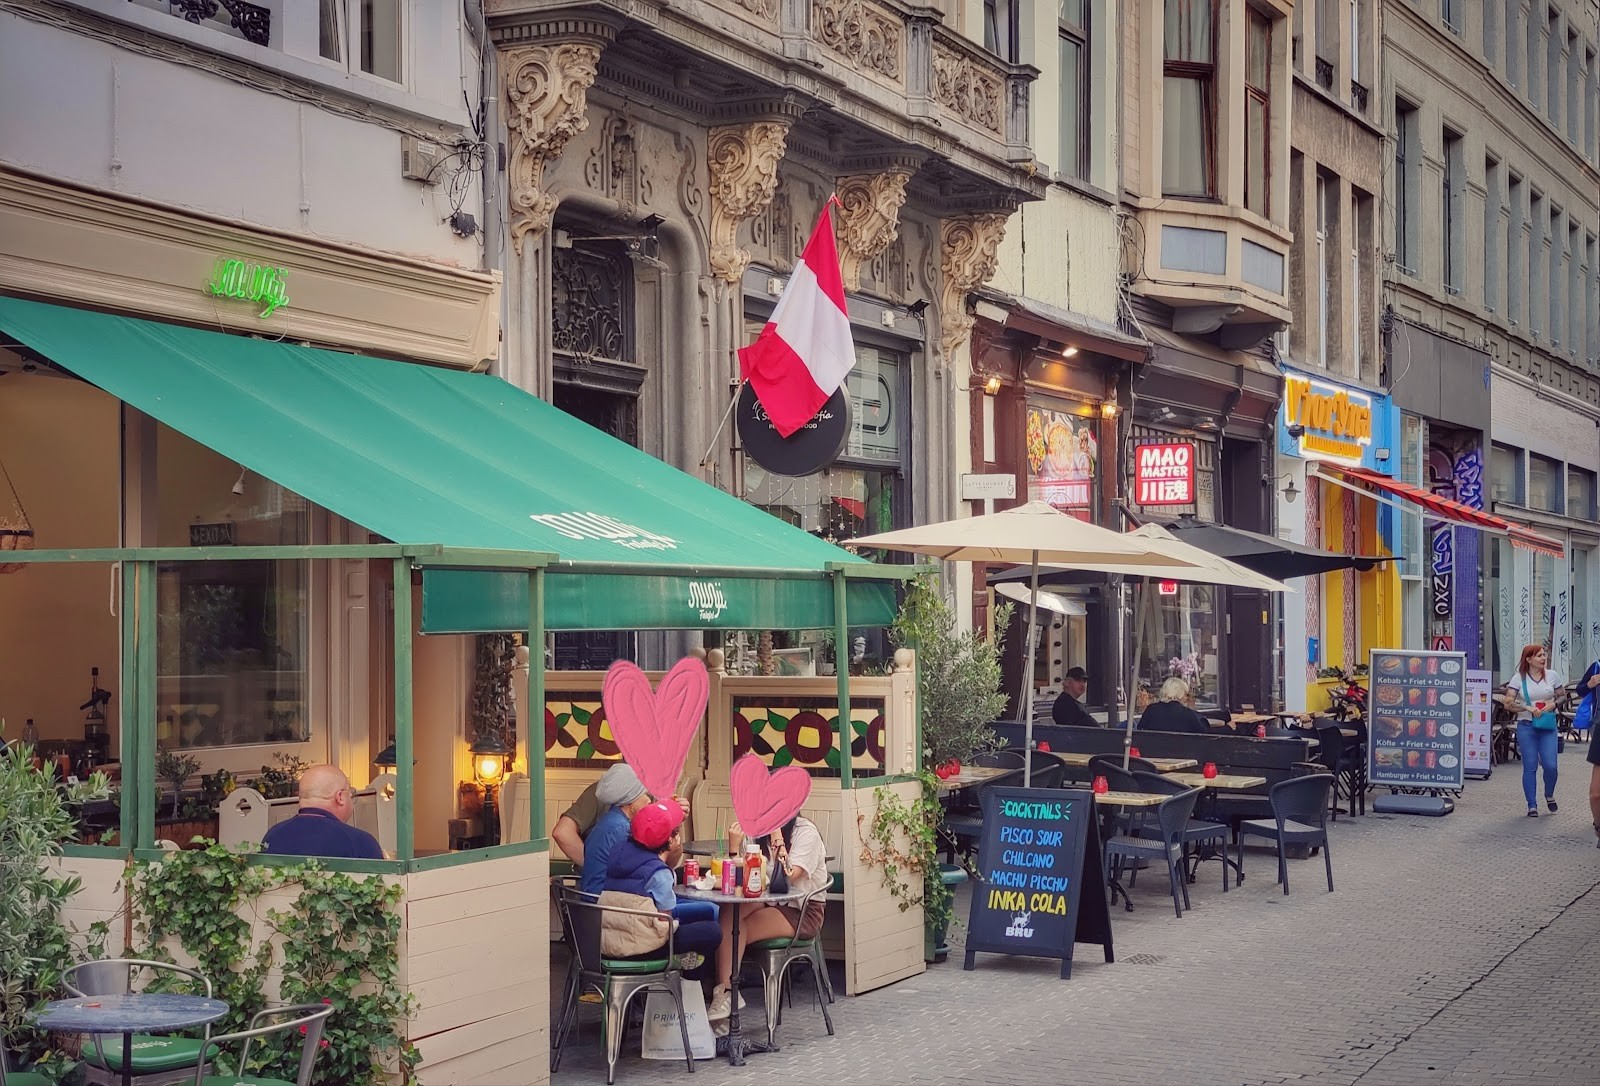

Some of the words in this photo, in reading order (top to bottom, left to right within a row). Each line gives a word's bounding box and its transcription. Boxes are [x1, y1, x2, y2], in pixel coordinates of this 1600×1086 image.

[1141, 447, 1189, 467] MAO
[1141, 466, 1189, 478] MASTER
[1141, 480, 1189, 502] 川魂
[1377, 676, 1401, 684] Kebab
[1434, 678, 1456, 686] Drank
[1377, 707, 1396, 715] Pizza
[1404, 708, 1421, 716] Friet
[1429, 709, 1452, 717] Drank
[1431, 741, 1454, 749] Drank
[1376, 771, 1409, 779] Hamburger
[1005, 801, 1061, 820] COCKTAILS
[1000, 826, 1033, 845] PISCO
[1036, 829, 1063, 847] SOUR
[1003, 849, 1054, 868] CHILCANO
[991, 870, 1027, 888] MACHU
[1030, 873, 1068, 892] PICCHU
[988, 890, 1026, 911] INKA
[1030, 893, 1067, 915] COLA
[1005, 926, 1035, 938] BRU
